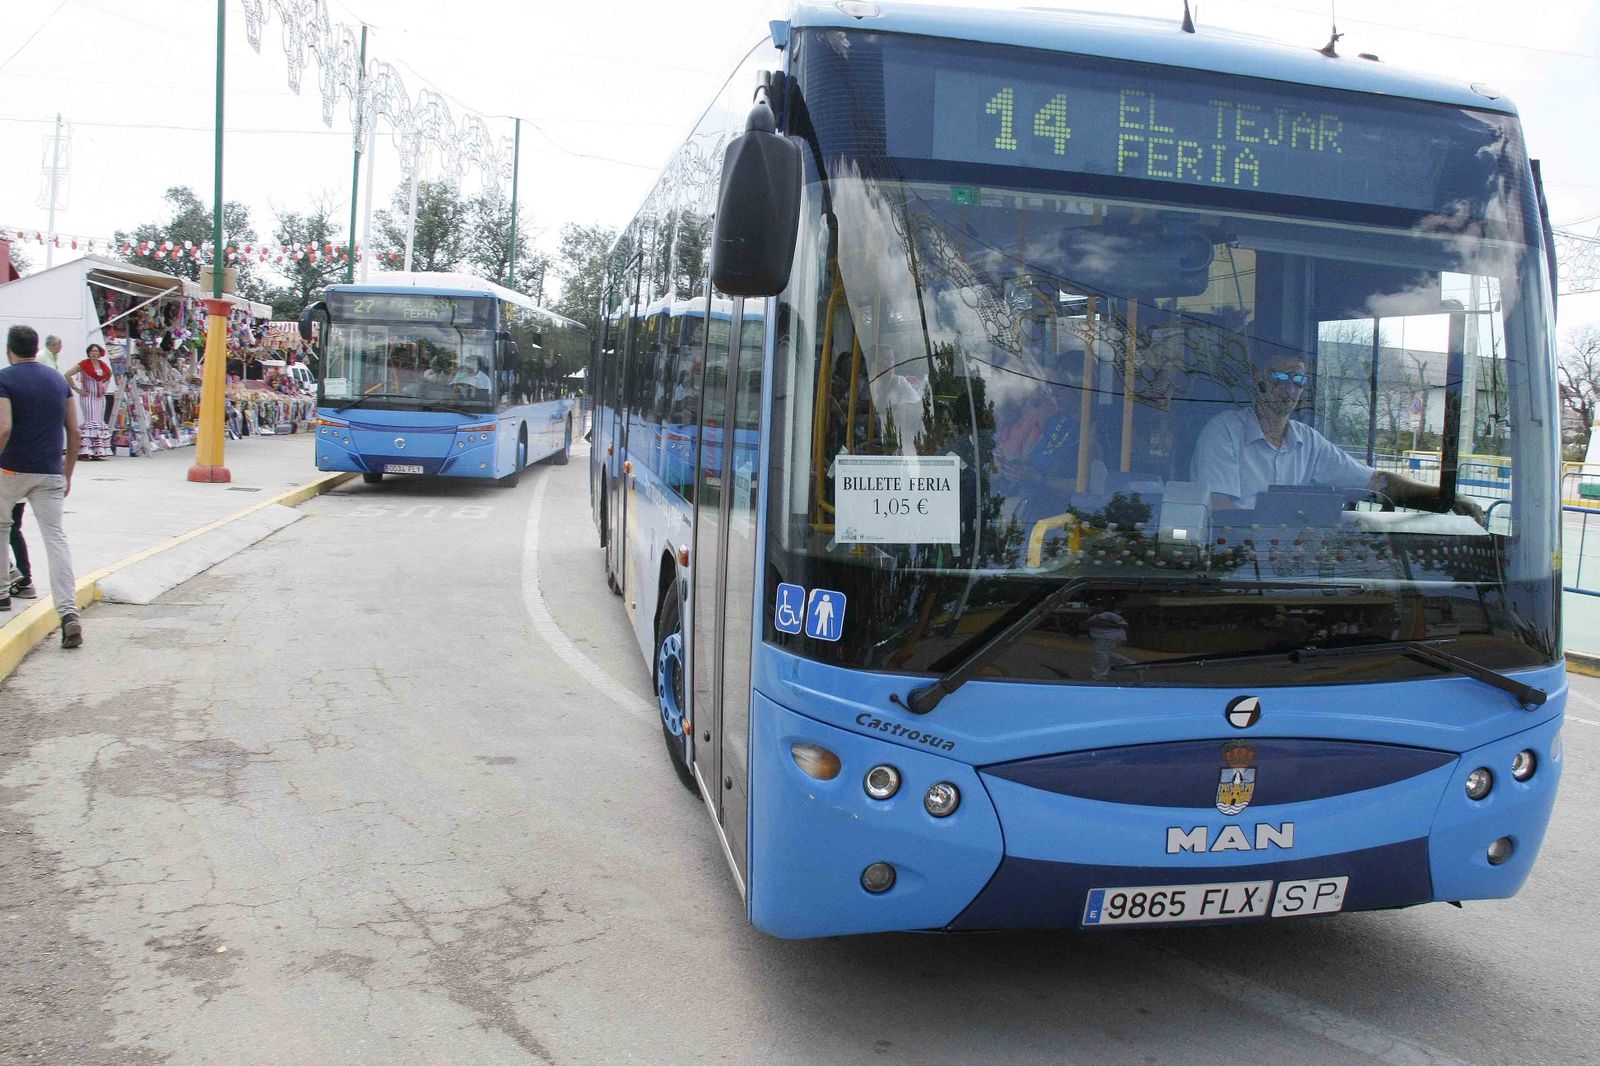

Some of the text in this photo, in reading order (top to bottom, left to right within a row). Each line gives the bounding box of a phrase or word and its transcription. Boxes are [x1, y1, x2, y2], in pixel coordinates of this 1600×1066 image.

[985, 87, 1072, 156] 14
[1119, 88, 1344, 154] EL TEJAR
[1117, 133, 1261, 187] FERIA
[354, 299, 375, 313] 27
[403, 308, 438, 319] FERIA
[843, 476, 951, 491] BILLETE FERIA
[873, 498, 929, 518] 1,05 €
[855, 712, 956, 751] Castrosua
[1166, 822, 1295, 854] MAN
[1107, 890, 1186, 920] 9865
[1199, 886, 1260, 916] FLX
[1282, 882, 1338, 912] SP
